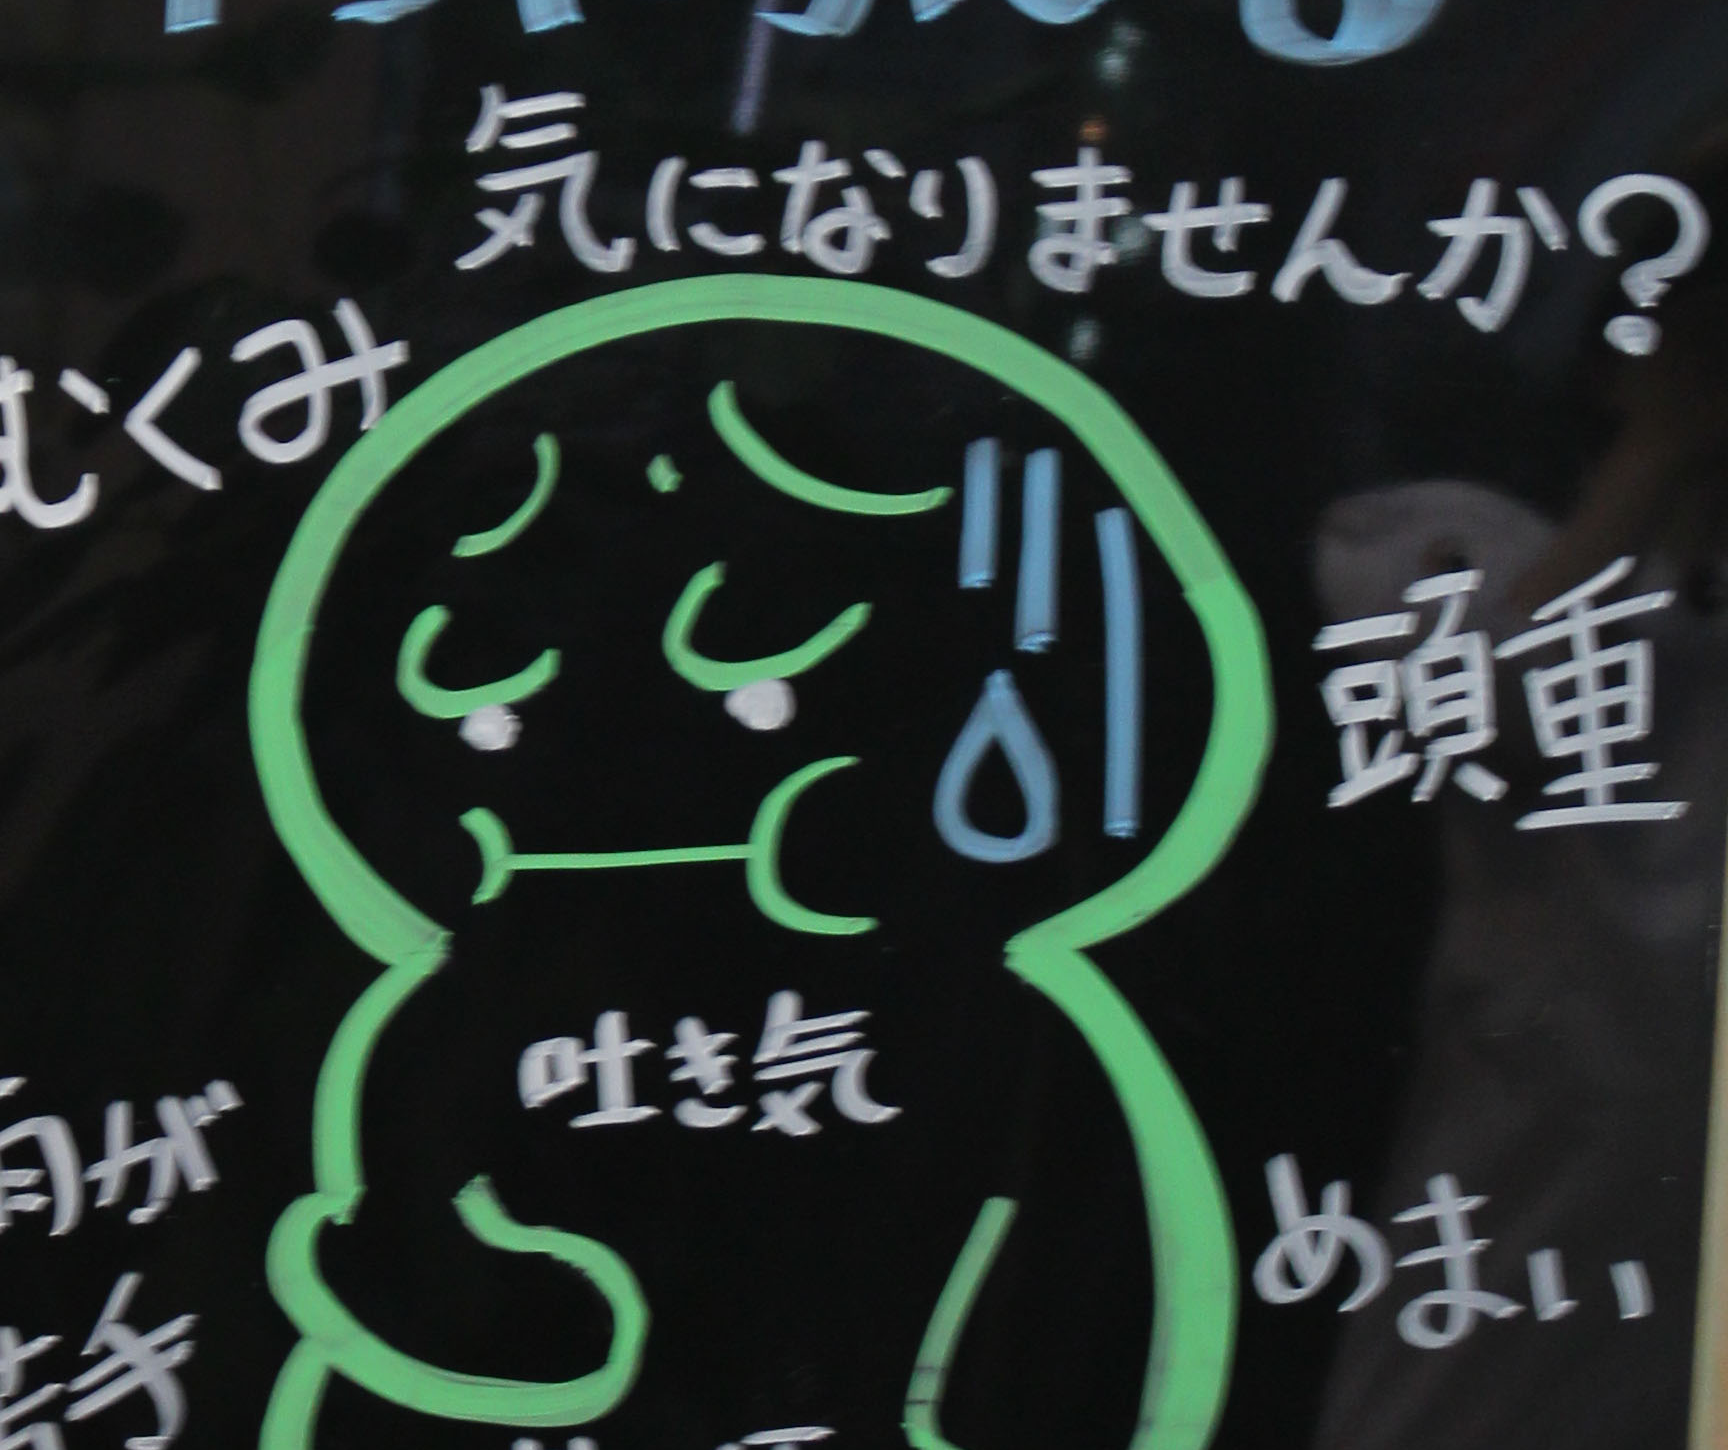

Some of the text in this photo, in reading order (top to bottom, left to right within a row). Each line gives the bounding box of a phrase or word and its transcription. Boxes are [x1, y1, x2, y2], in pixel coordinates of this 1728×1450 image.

[1311, 555, 1692, 831] 頭重
[516, 990, 902, 1139] 吐き気
[1253, 1152, 1652, 1349] めまい
